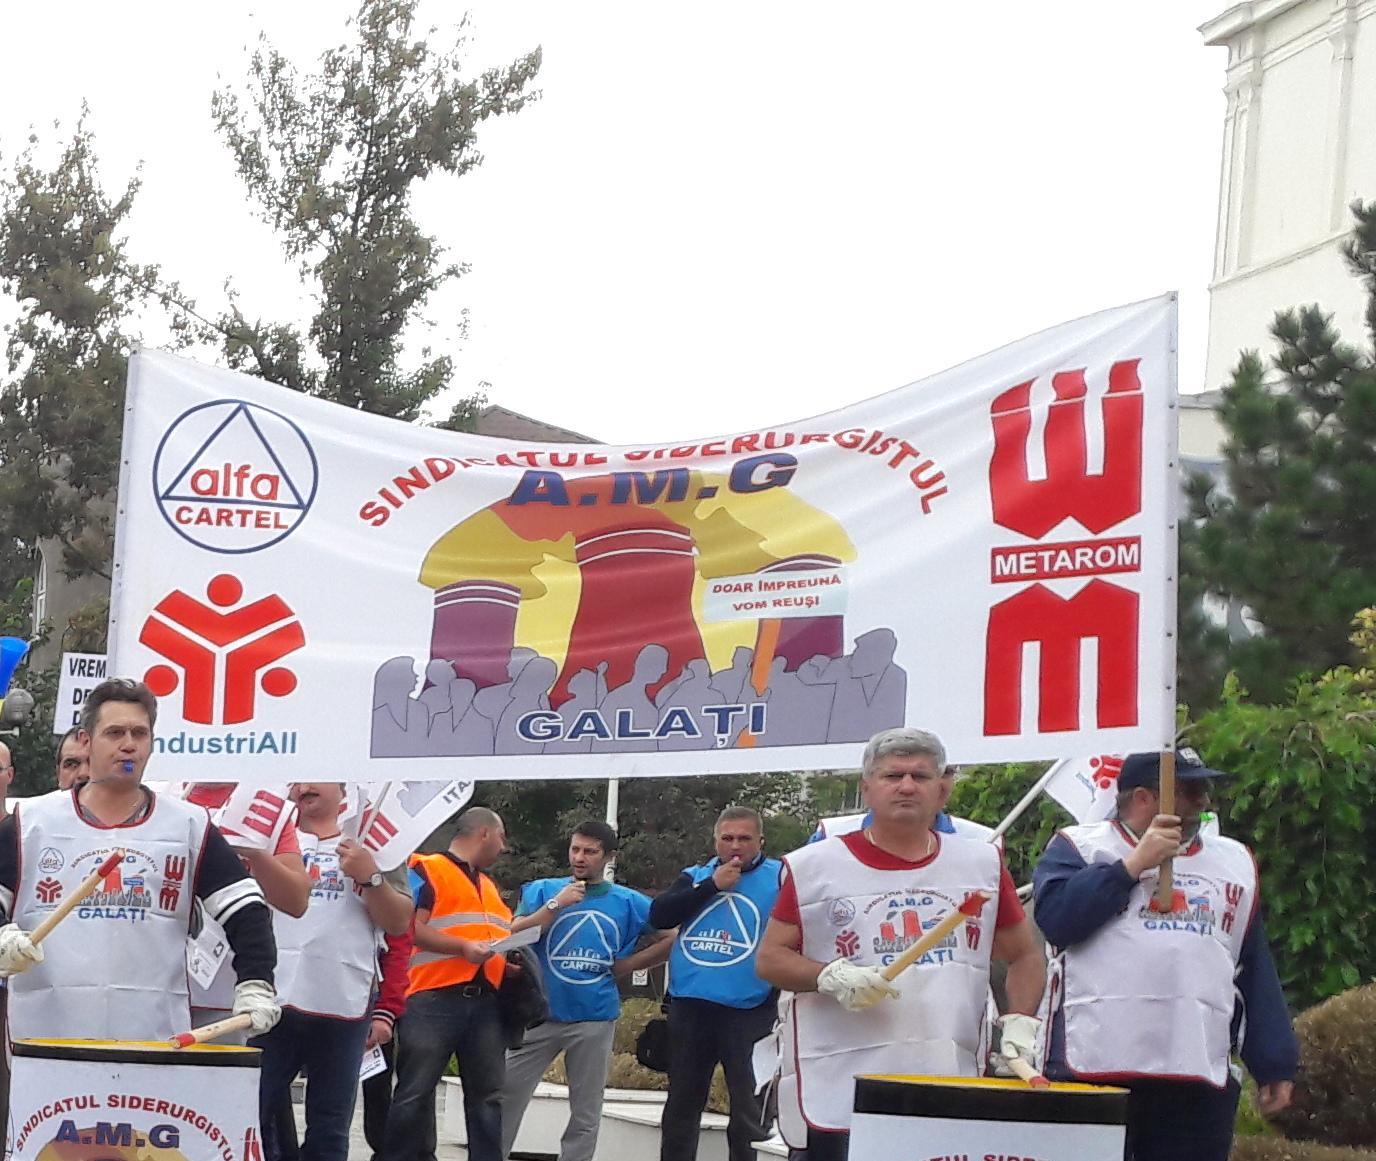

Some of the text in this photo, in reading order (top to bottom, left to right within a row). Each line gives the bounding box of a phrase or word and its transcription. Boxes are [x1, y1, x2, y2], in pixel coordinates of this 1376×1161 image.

[190, 463, 279, 501] alfa
[506, 453, 798, 506] A.M.G
[175, 506, 289, 530] CARTEL
[995, 542, 1139, 577] METAROM
[713, 582, 754, 594] DOAR
[733, 599, 768, 611] VOM
[69, 658, 106, 678] VREM
[517, 702, 766, 749] GALAȚI
[151, 732, 297, 756] ndustriAll
[691, 941, 734, 955] CARTEL
[16, 1095, 100, 1153] SINDICATUL
[56, 1119, 180, 1149] A.M.G
